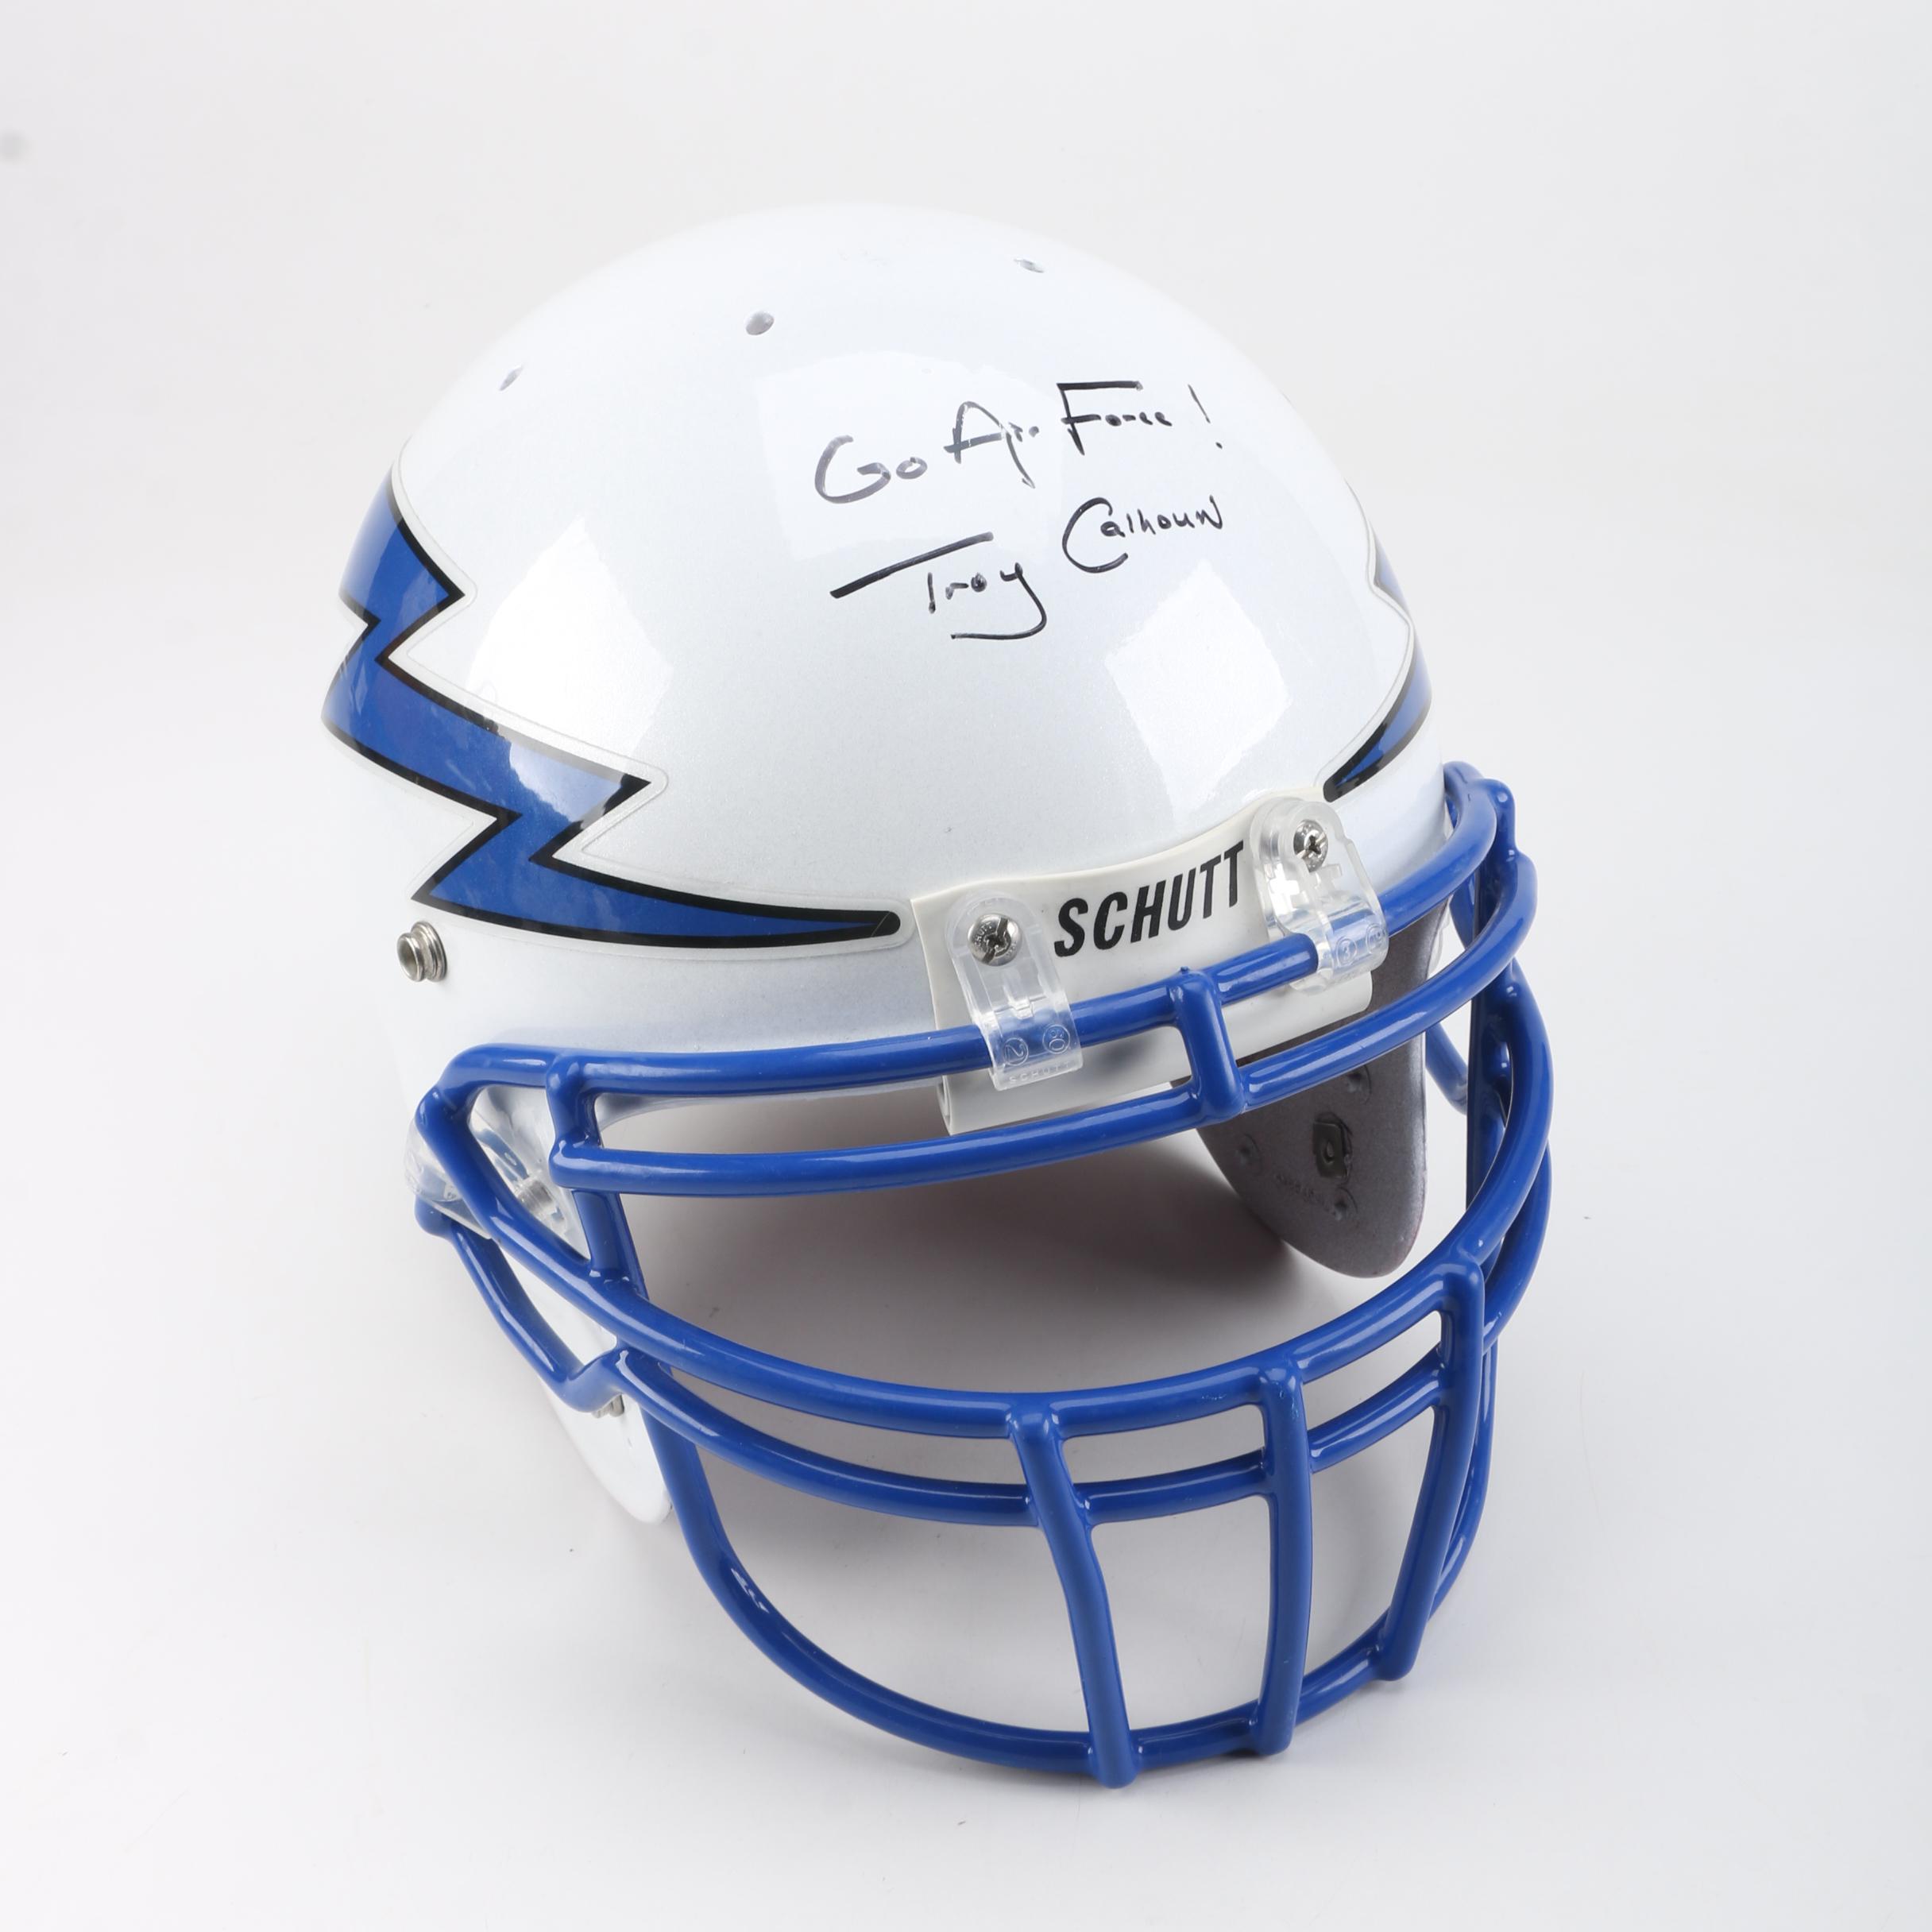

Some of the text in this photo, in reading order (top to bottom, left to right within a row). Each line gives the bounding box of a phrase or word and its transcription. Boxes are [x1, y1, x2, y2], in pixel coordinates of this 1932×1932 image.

[815, 435, 928, 504] Go
[829, 531, 1049, 641] Troy
[1053, 840, 1244, 957] SCHUTT
